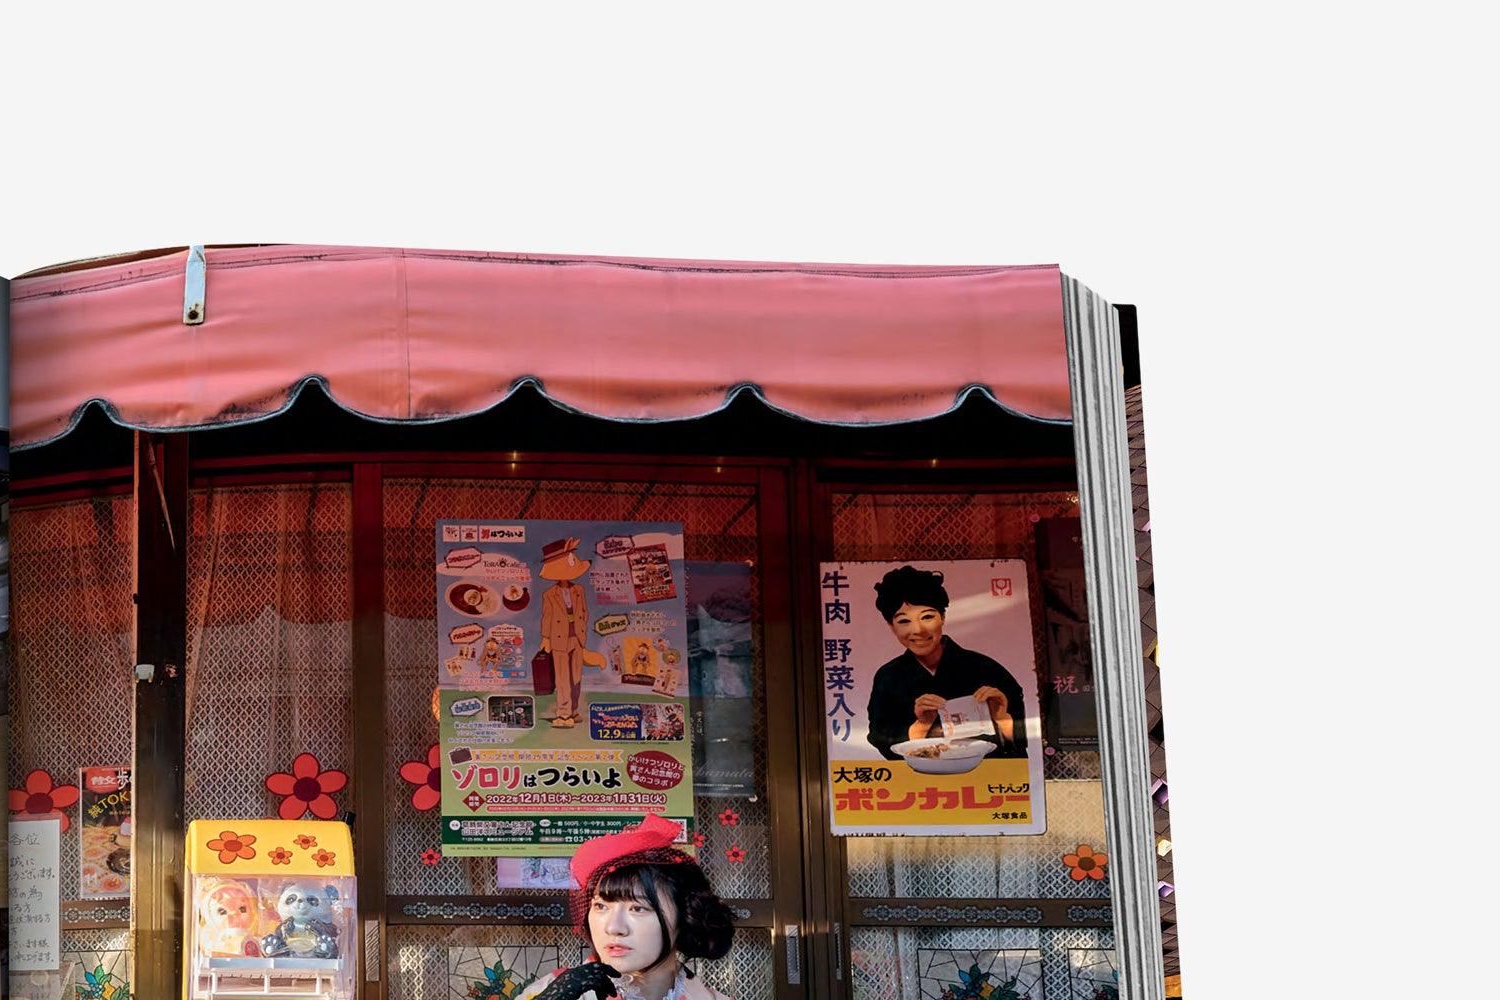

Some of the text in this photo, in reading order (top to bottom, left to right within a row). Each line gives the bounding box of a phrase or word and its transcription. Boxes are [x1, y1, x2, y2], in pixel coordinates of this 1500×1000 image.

[822, 570, 855, 742] 牛肉 野菜入り
[452, 765, 622, 789] ゾロリはつらいよ
[833, 767, 892, 783] 大塚の
[988, 783, 1030, 793] ヒートパック
[835, 786, 1030, 811] ボンカレー
[992, 811, 1028, 820] 大塚食品
